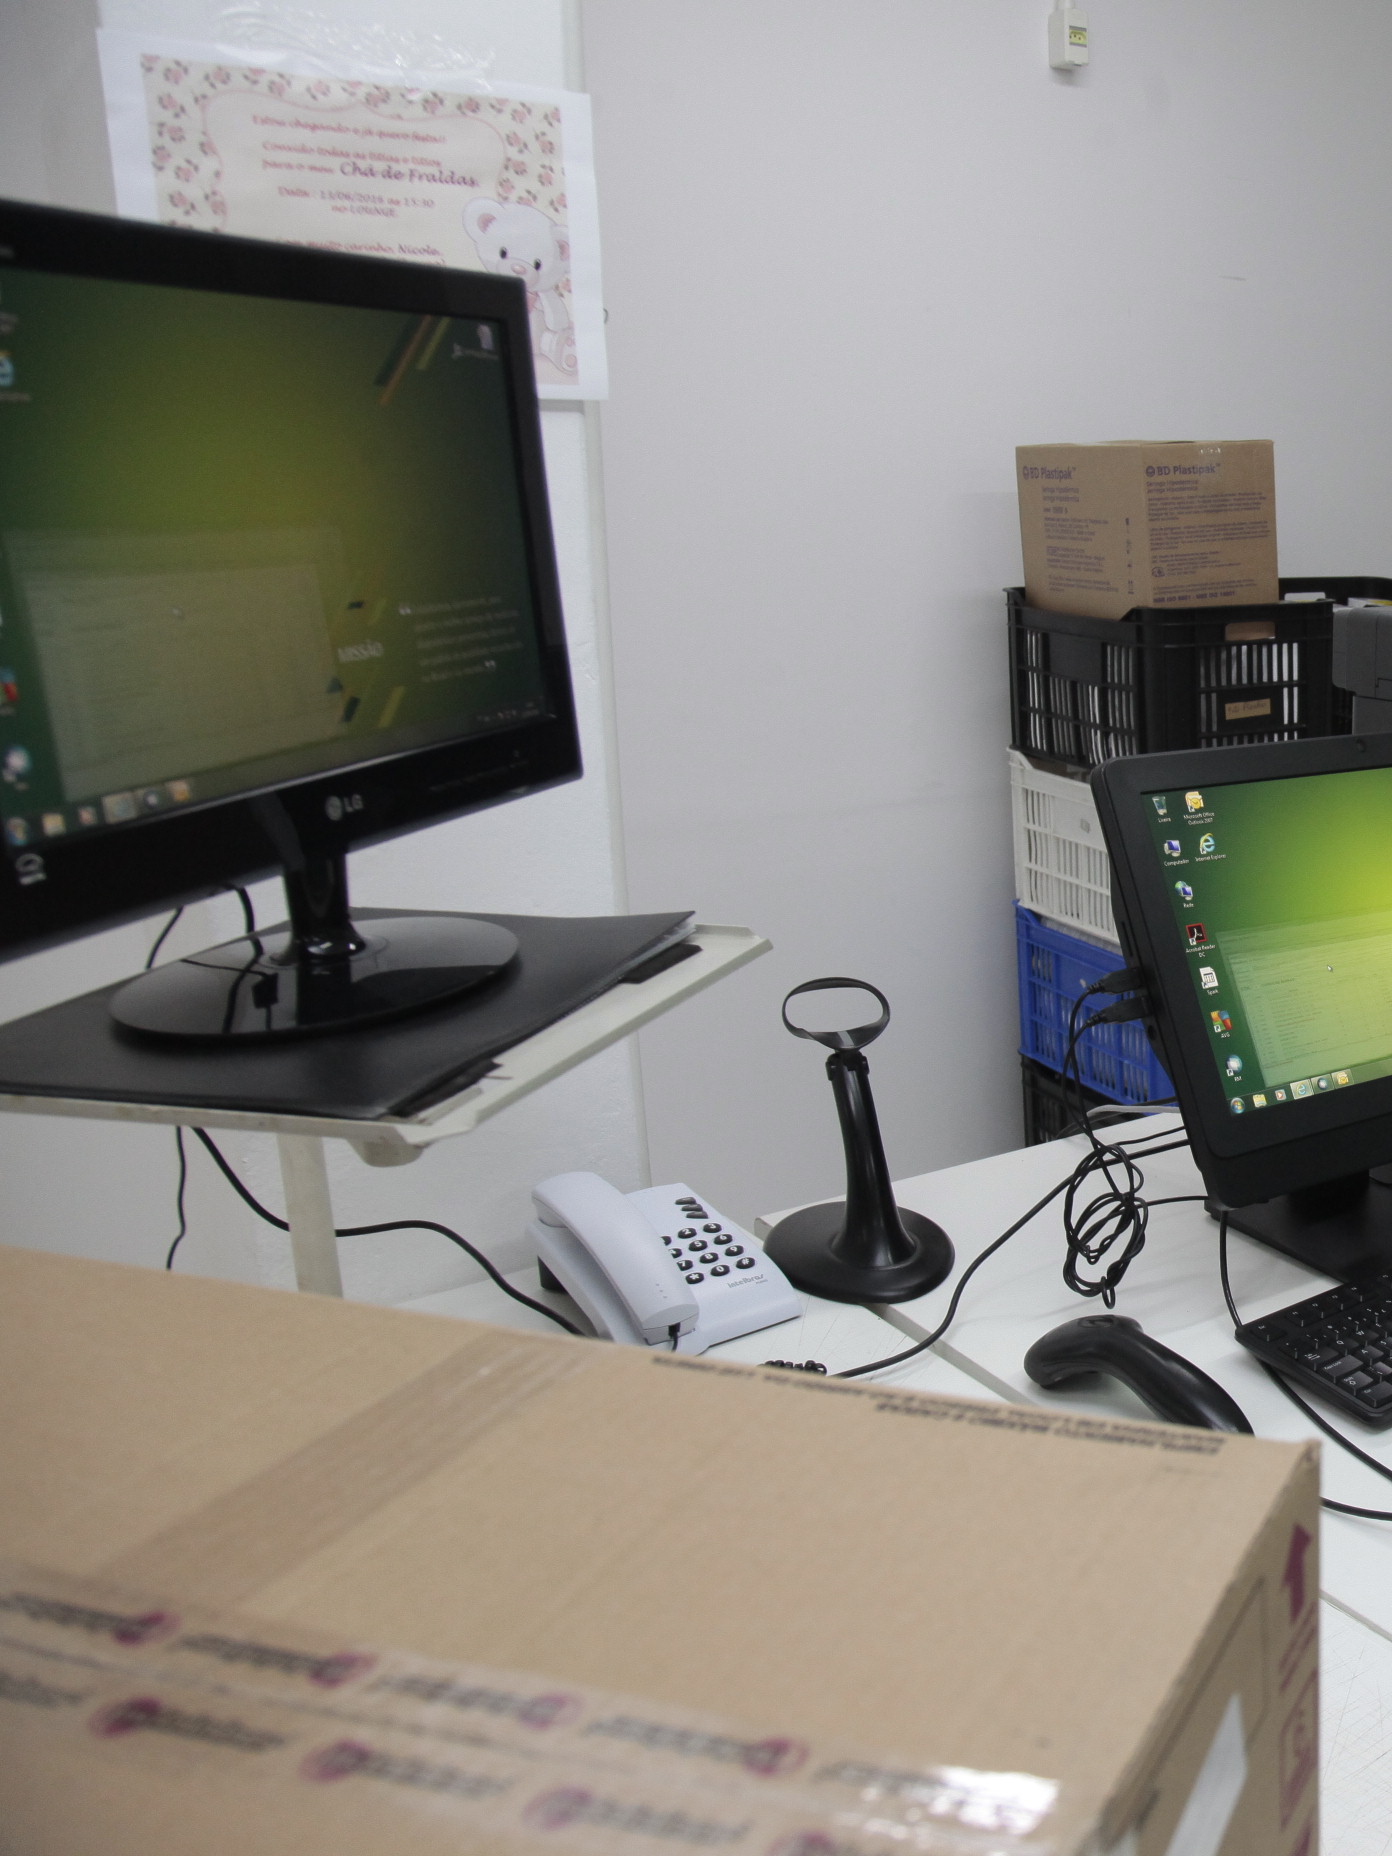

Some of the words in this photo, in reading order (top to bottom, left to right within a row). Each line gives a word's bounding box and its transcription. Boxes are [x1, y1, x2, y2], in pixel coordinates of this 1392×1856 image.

[381, 165, 404, 180] de
[1041, 466, 1073, 481] Plastipak
[1157, 466, 1171, 476] BD
[1173, 464, 1216, 477] Plastipak
[343, 794, 364, 813] LG
[1164, 859, 1190, 867] Computador
[727, 1273, 764, 1289] intelbras
